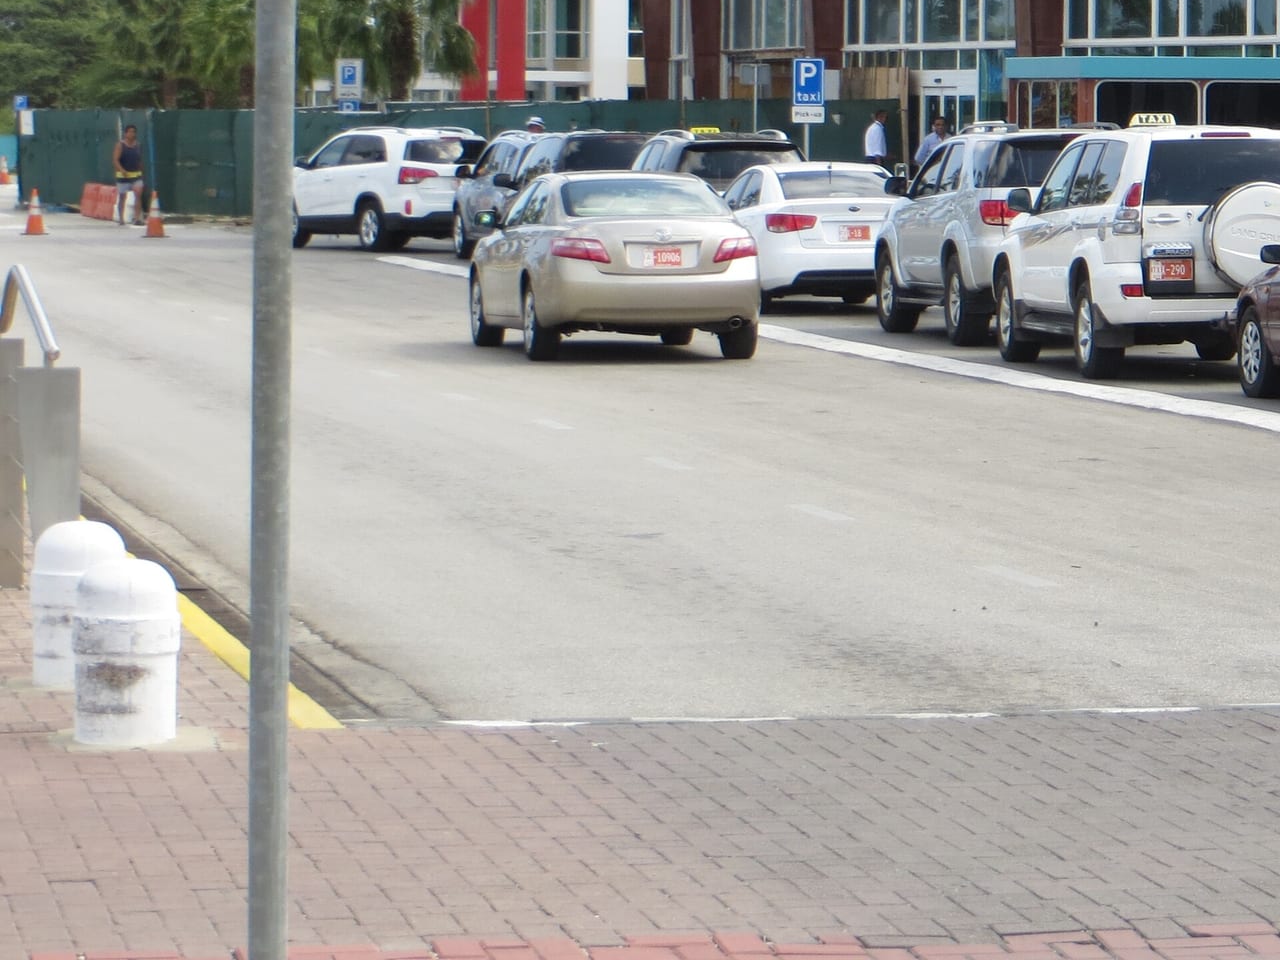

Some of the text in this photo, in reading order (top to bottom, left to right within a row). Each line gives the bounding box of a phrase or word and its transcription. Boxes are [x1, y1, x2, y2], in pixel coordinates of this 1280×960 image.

[344, 67, 355, 79] P
[800, 62, 817, 86] P
[797, 91, 821, 102] taxi
[1139, 114, 1171, 124] TAXI
